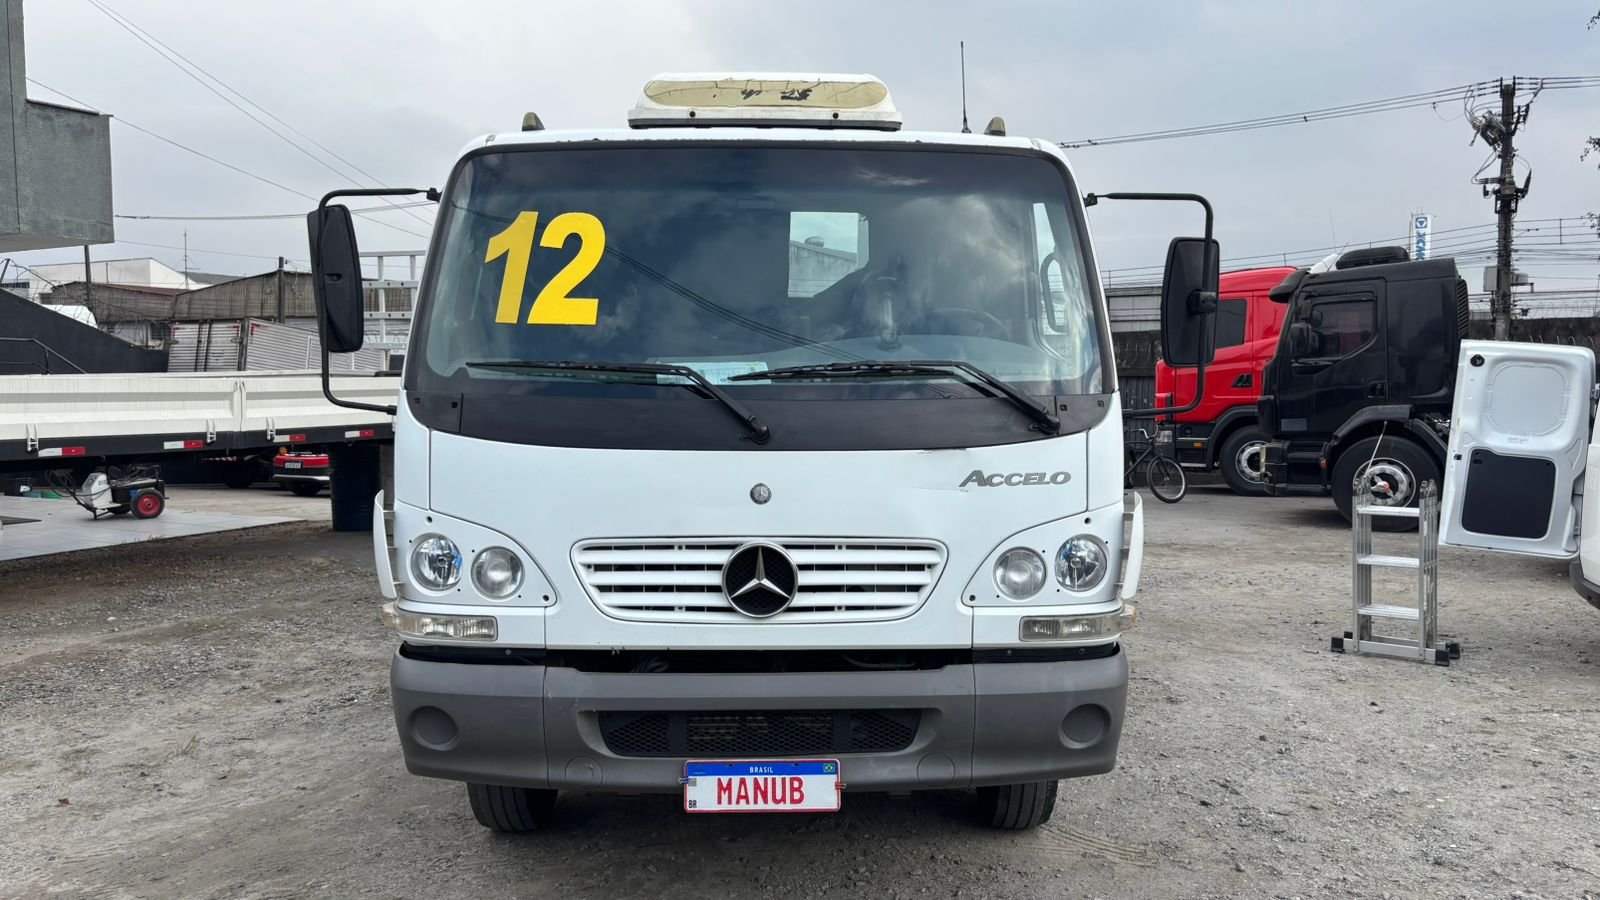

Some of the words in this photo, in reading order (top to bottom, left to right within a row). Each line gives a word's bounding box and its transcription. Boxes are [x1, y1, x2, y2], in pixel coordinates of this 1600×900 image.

[484, 211, 606, 325] 12
[958, 470, 1072, 487] ACCELO
[749, 766, 774, 774] BRASIL
[716, 776, 806, 806] MANUB
[688, 799, 697, 809] BR
